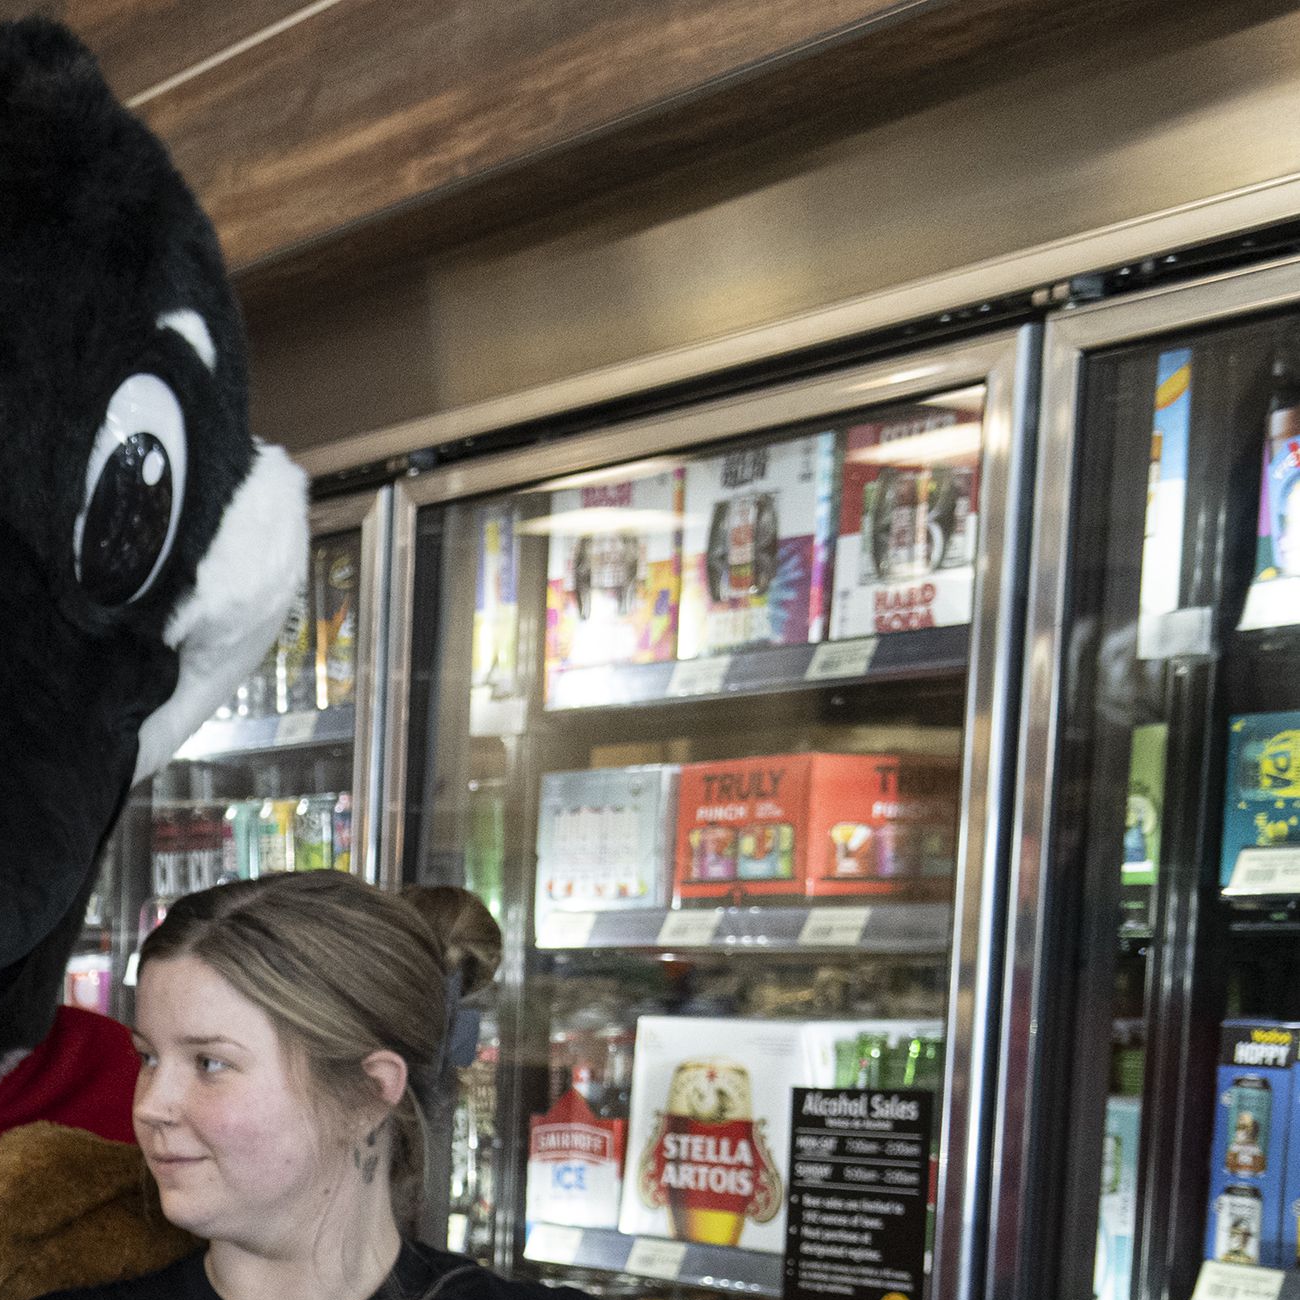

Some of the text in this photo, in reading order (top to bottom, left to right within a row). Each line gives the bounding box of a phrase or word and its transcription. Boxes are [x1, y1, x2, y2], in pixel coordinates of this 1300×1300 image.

[702, 768, 786, 800] TRULY
[802, 1092, 919, 1121] Alcohol Sales
[664, 1131, 754, 1166] STELLA
[550, 1163, 589, 1191] ICE
[660, 1166, 754, 1198] ARTOIS
